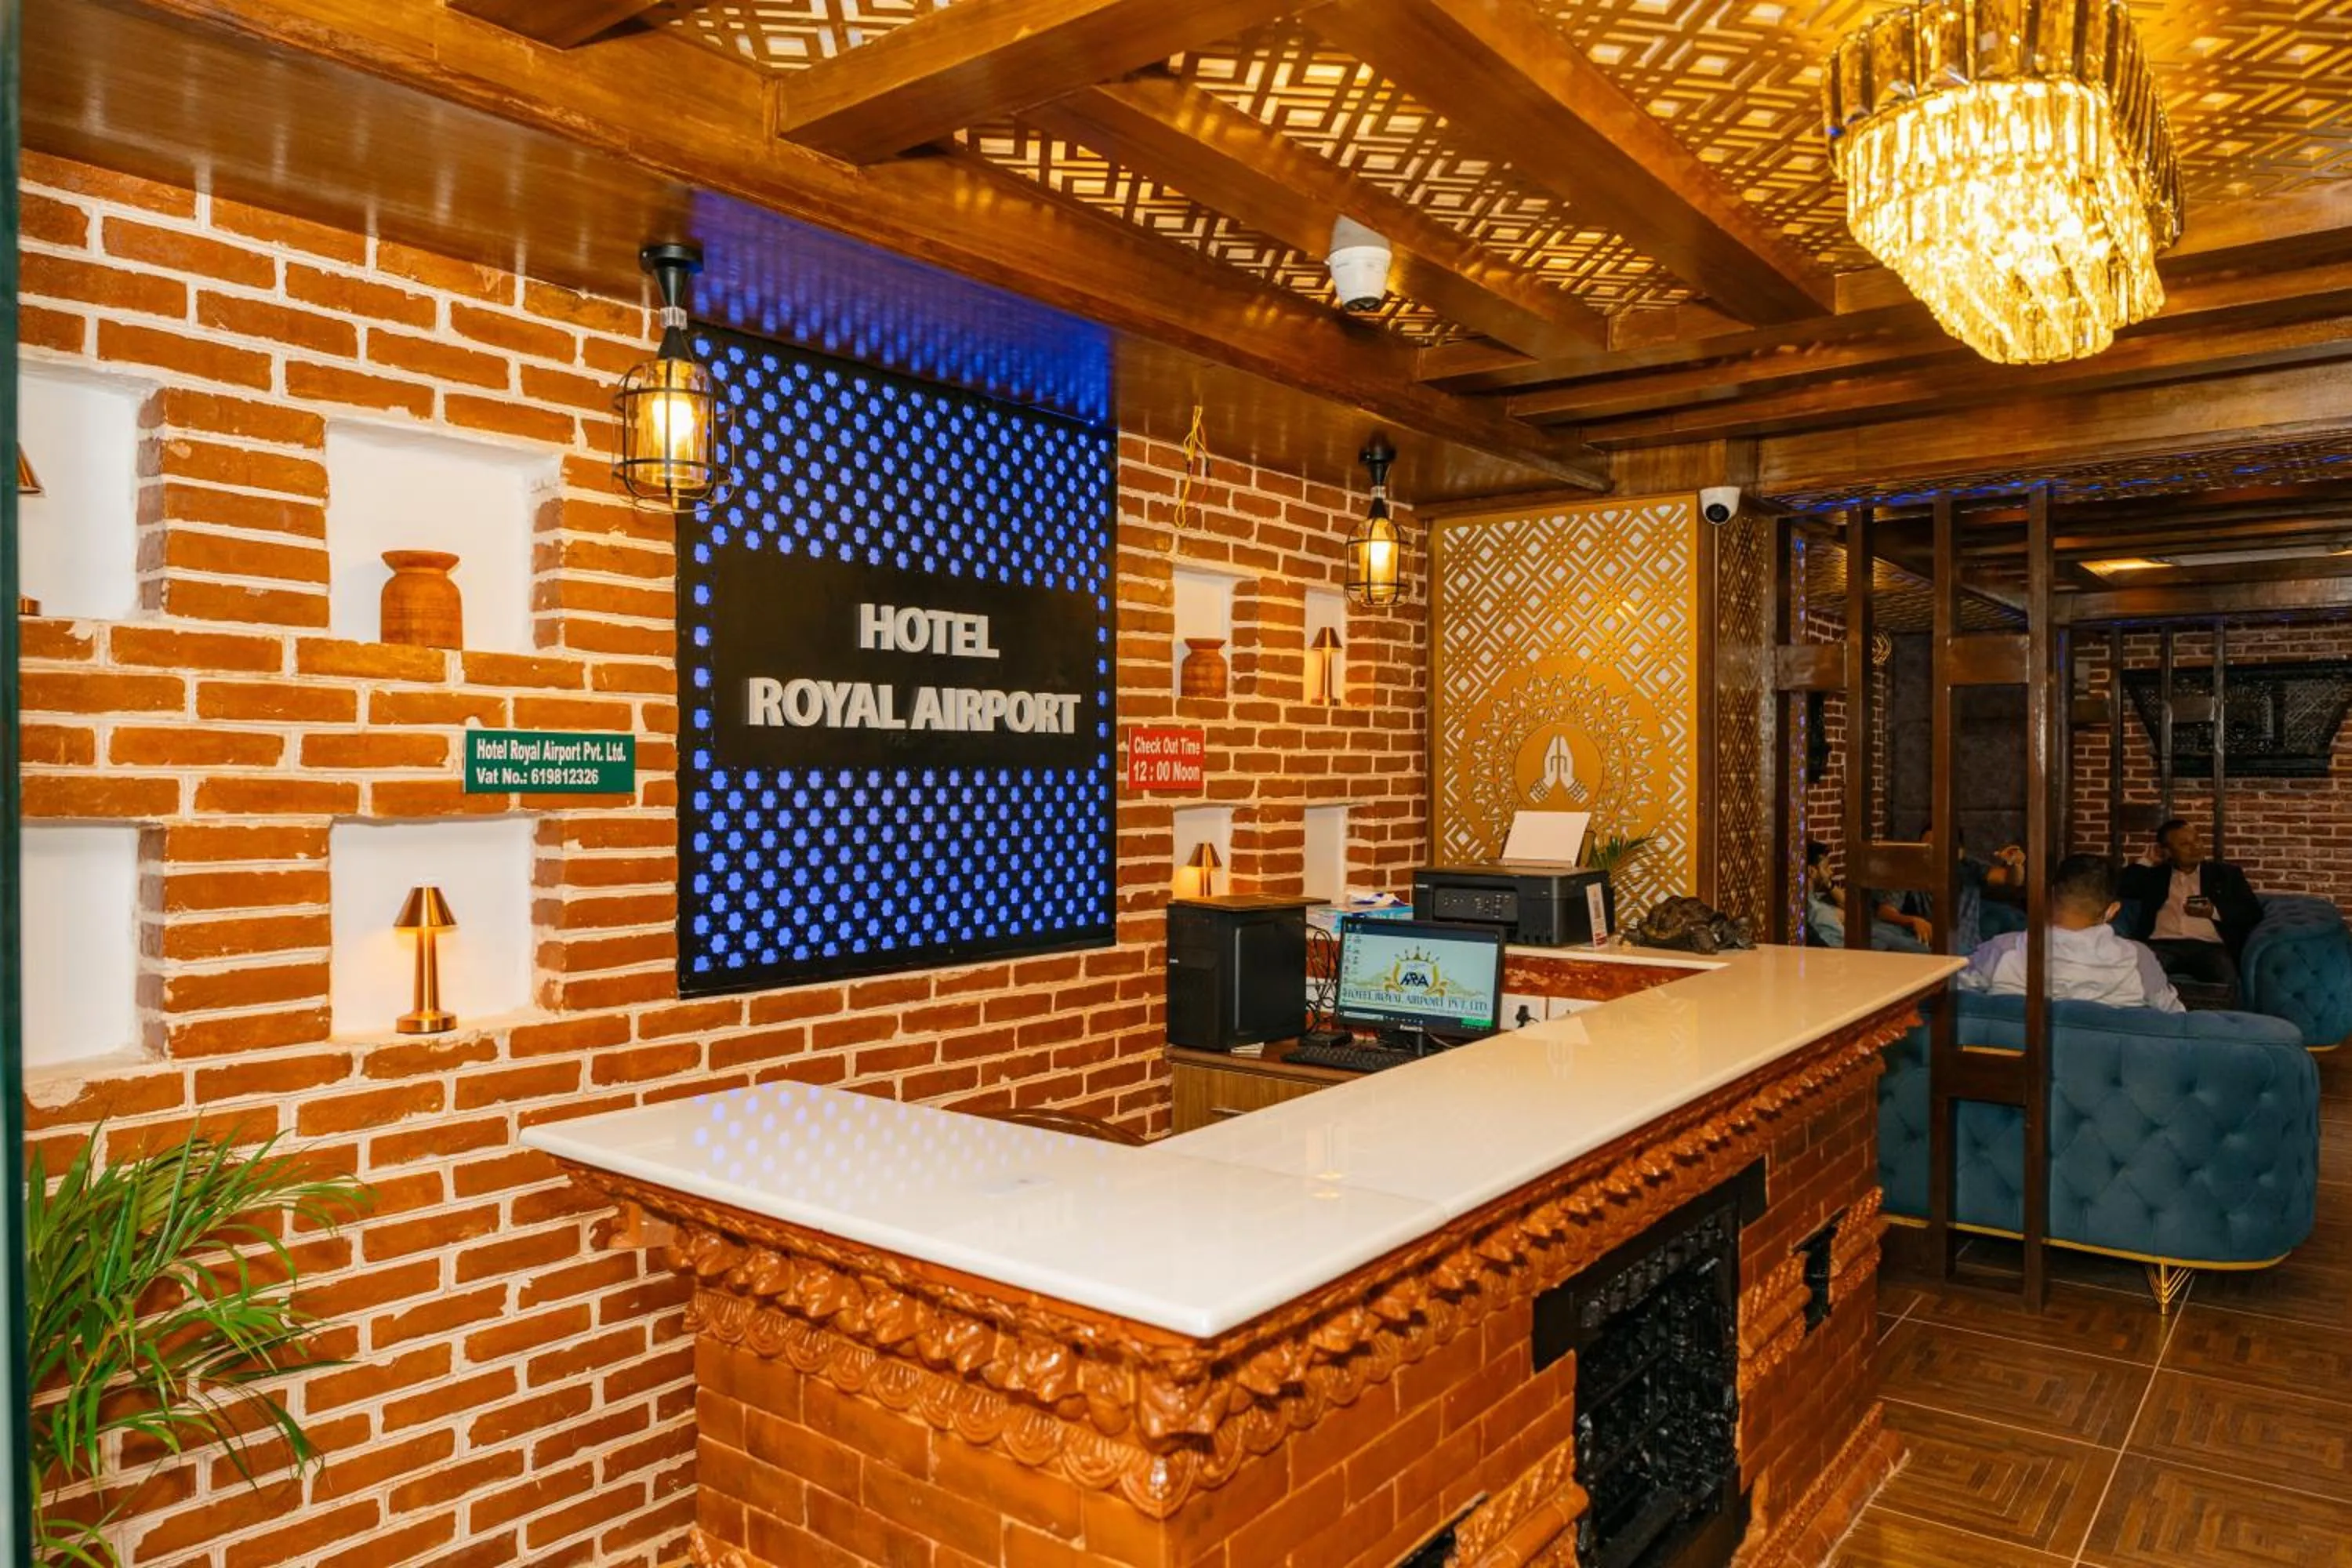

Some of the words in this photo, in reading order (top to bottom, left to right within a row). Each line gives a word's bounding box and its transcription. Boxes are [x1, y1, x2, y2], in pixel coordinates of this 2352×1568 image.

[859, 603, 1000, 659] HOTEL
[748, 677, 906, 729] ROYAL
[910, 686, 1081, 734] AIRPORT
[476, 738, 507, 760] Hotel
[510, 739, 540, 765] Royal
[543, 741, 581, 766] Airport
[583, 742, 604, 761] Pvt.
[606, 742, 626, 762] Ltd.
[1134, 736, 1161, 753] Check
[1163, 737, 1178, 754] Out
[1180, 738, 1201, 755] Time
[476, 767, 499, 784] Vat
[531, 768, 599, 785] 619812326
[1173, 760, 1200, 781] Noon
